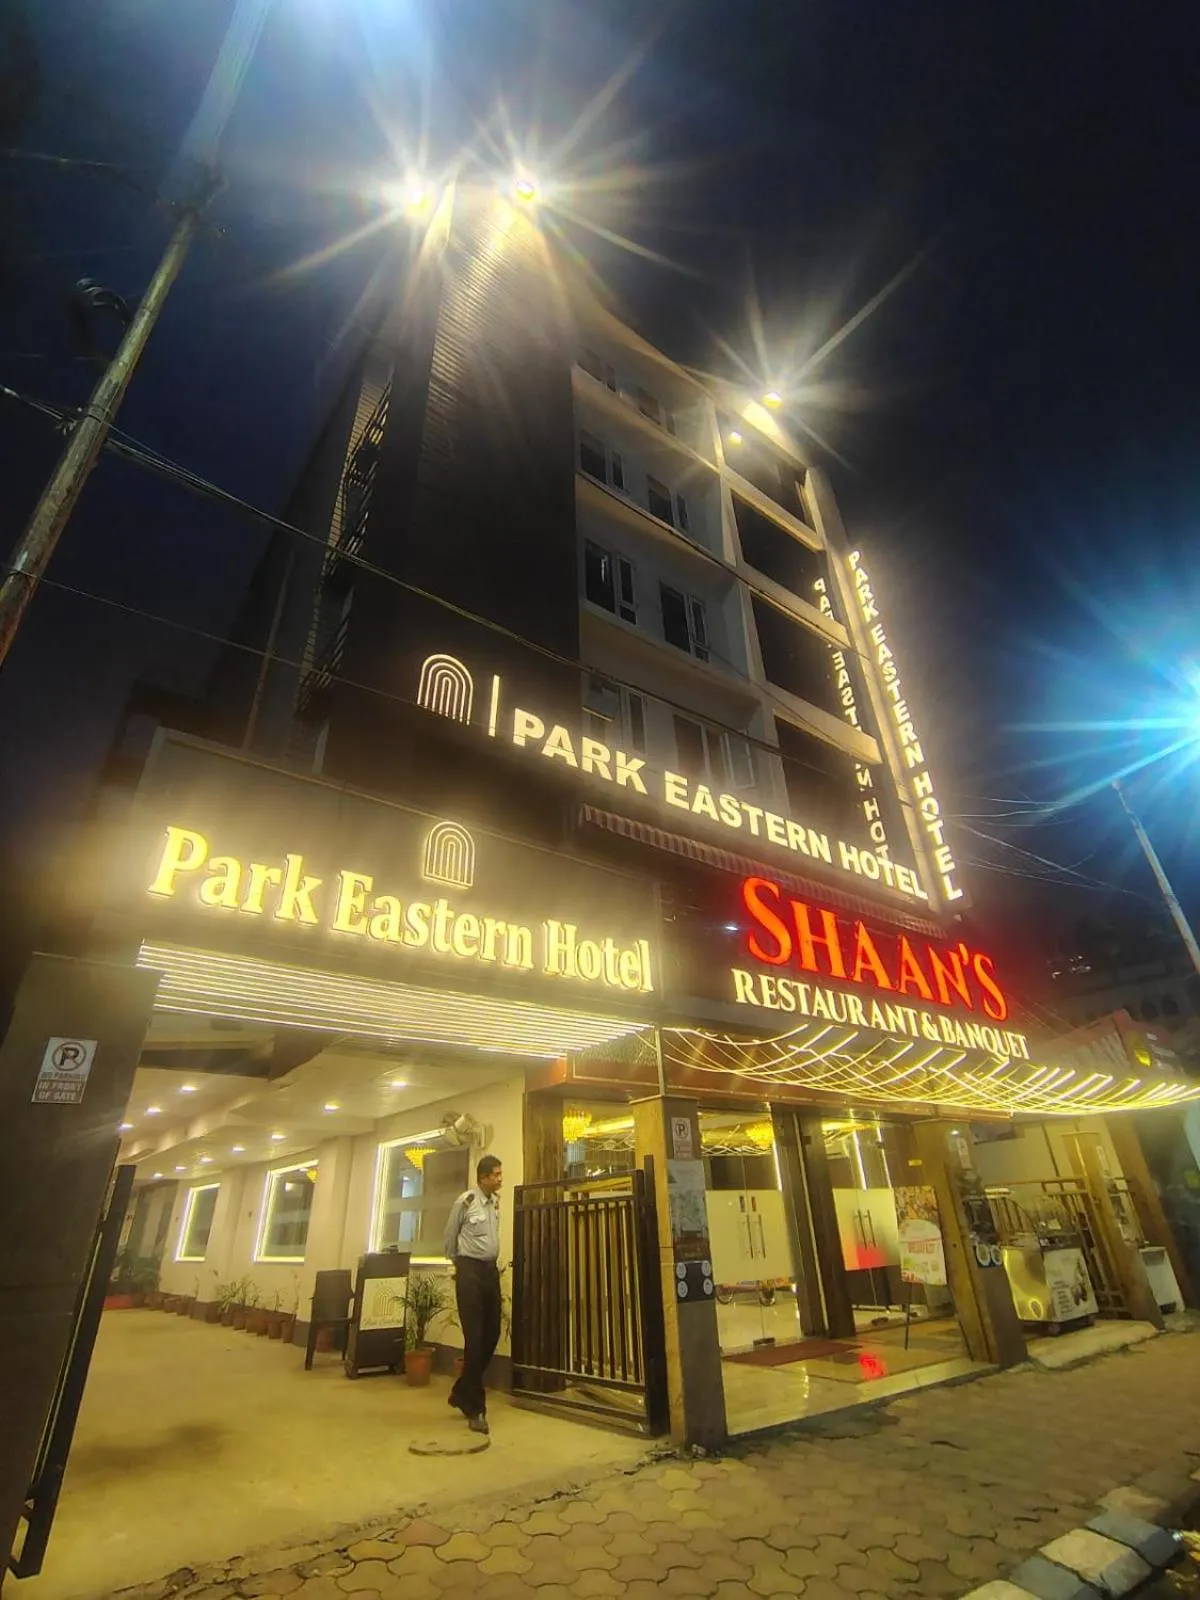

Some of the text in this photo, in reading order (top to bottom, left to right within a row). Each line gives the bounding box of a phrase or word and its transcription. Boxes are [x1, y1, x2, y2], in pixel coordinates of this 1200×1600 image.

[511, 707, 930, 900] PARK EASTERN HOTEL
[848, 550, 964, 901] PARK EASTERN HOTEL
[148, 825, 655, 993] Park Eastern Hotel
[742, 876, 1008, 1022] SHAAN'S
